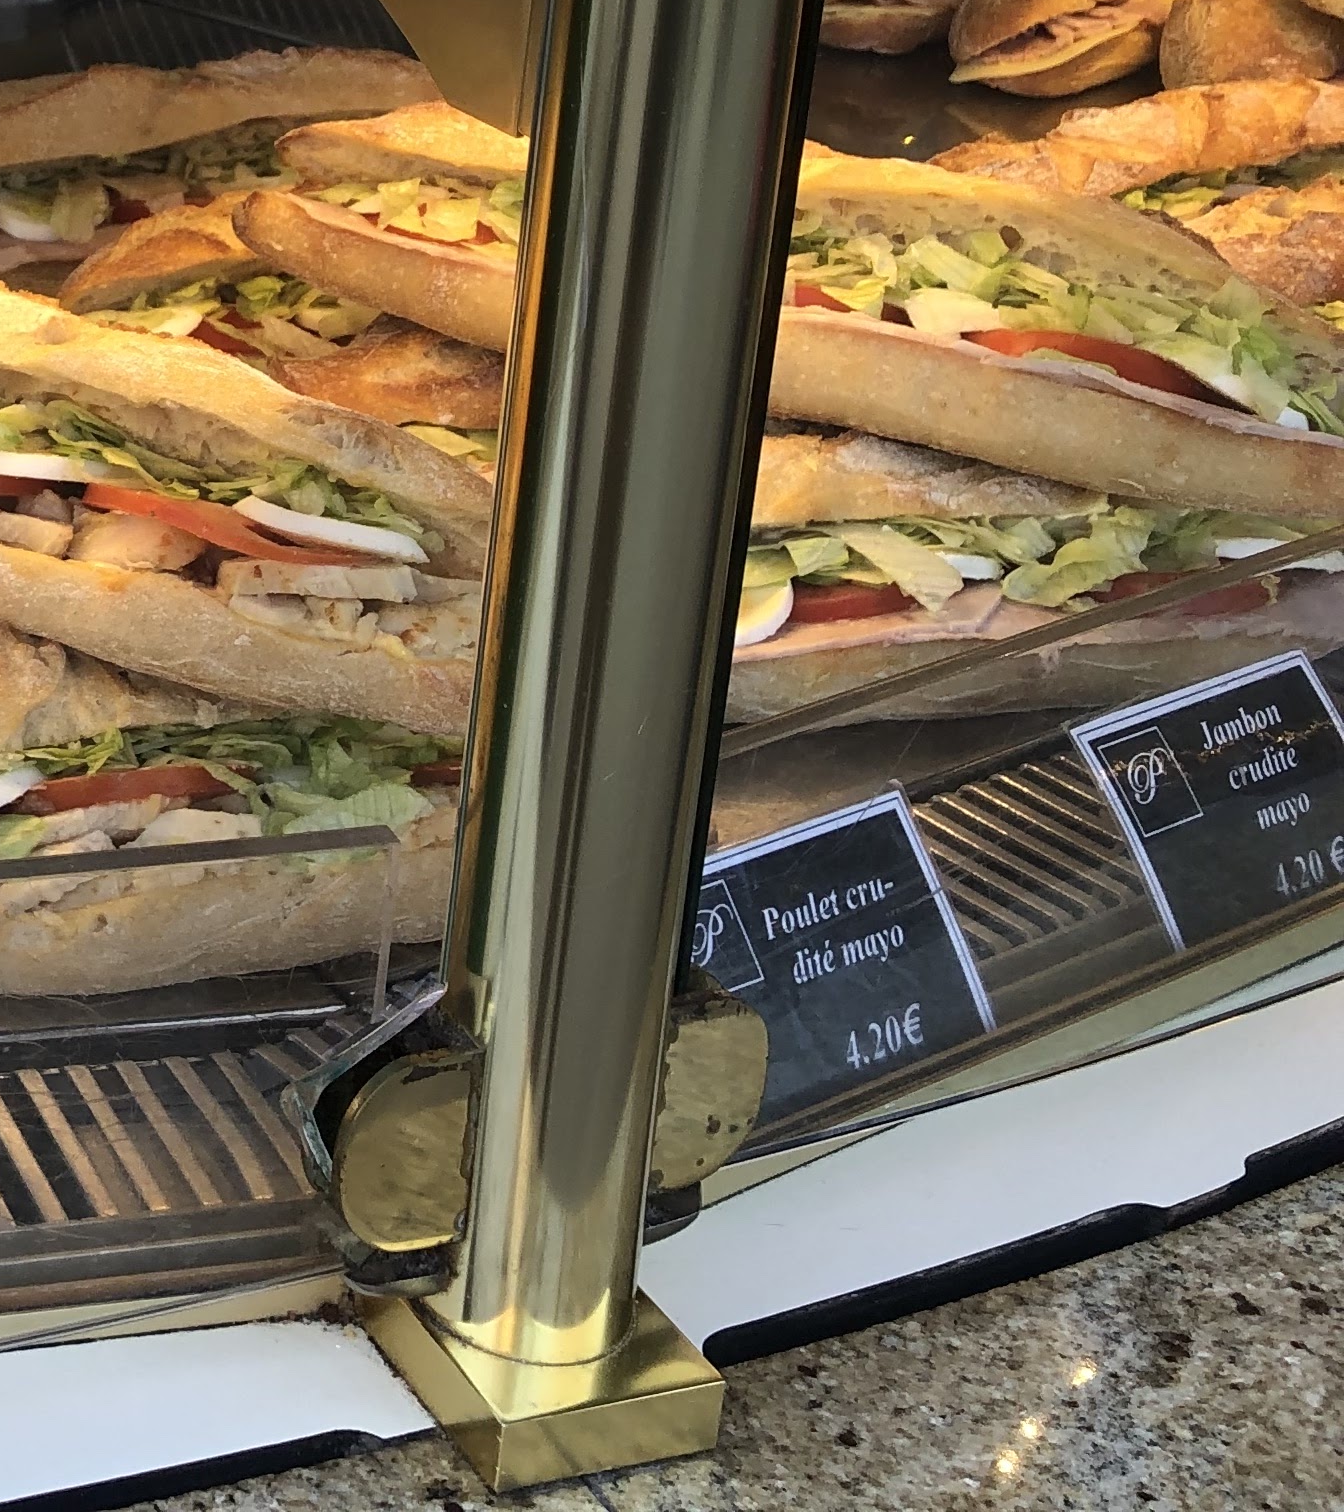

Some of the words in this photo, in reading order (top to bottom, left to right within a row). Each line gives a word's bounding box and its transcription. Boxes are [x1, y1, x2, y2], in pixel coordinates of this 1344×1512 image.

[1200, 703, 1282, 750] Jambon
[1256, 792, 1311, 830] mayo
[761, 889, 842, 941] Poulet
[846, 876, 895, 910] cru-
[792, 940, 837, 985] dité
[841, 924, 905, 967] mayo
[846, 1003, 925, 1070] 4.20€
